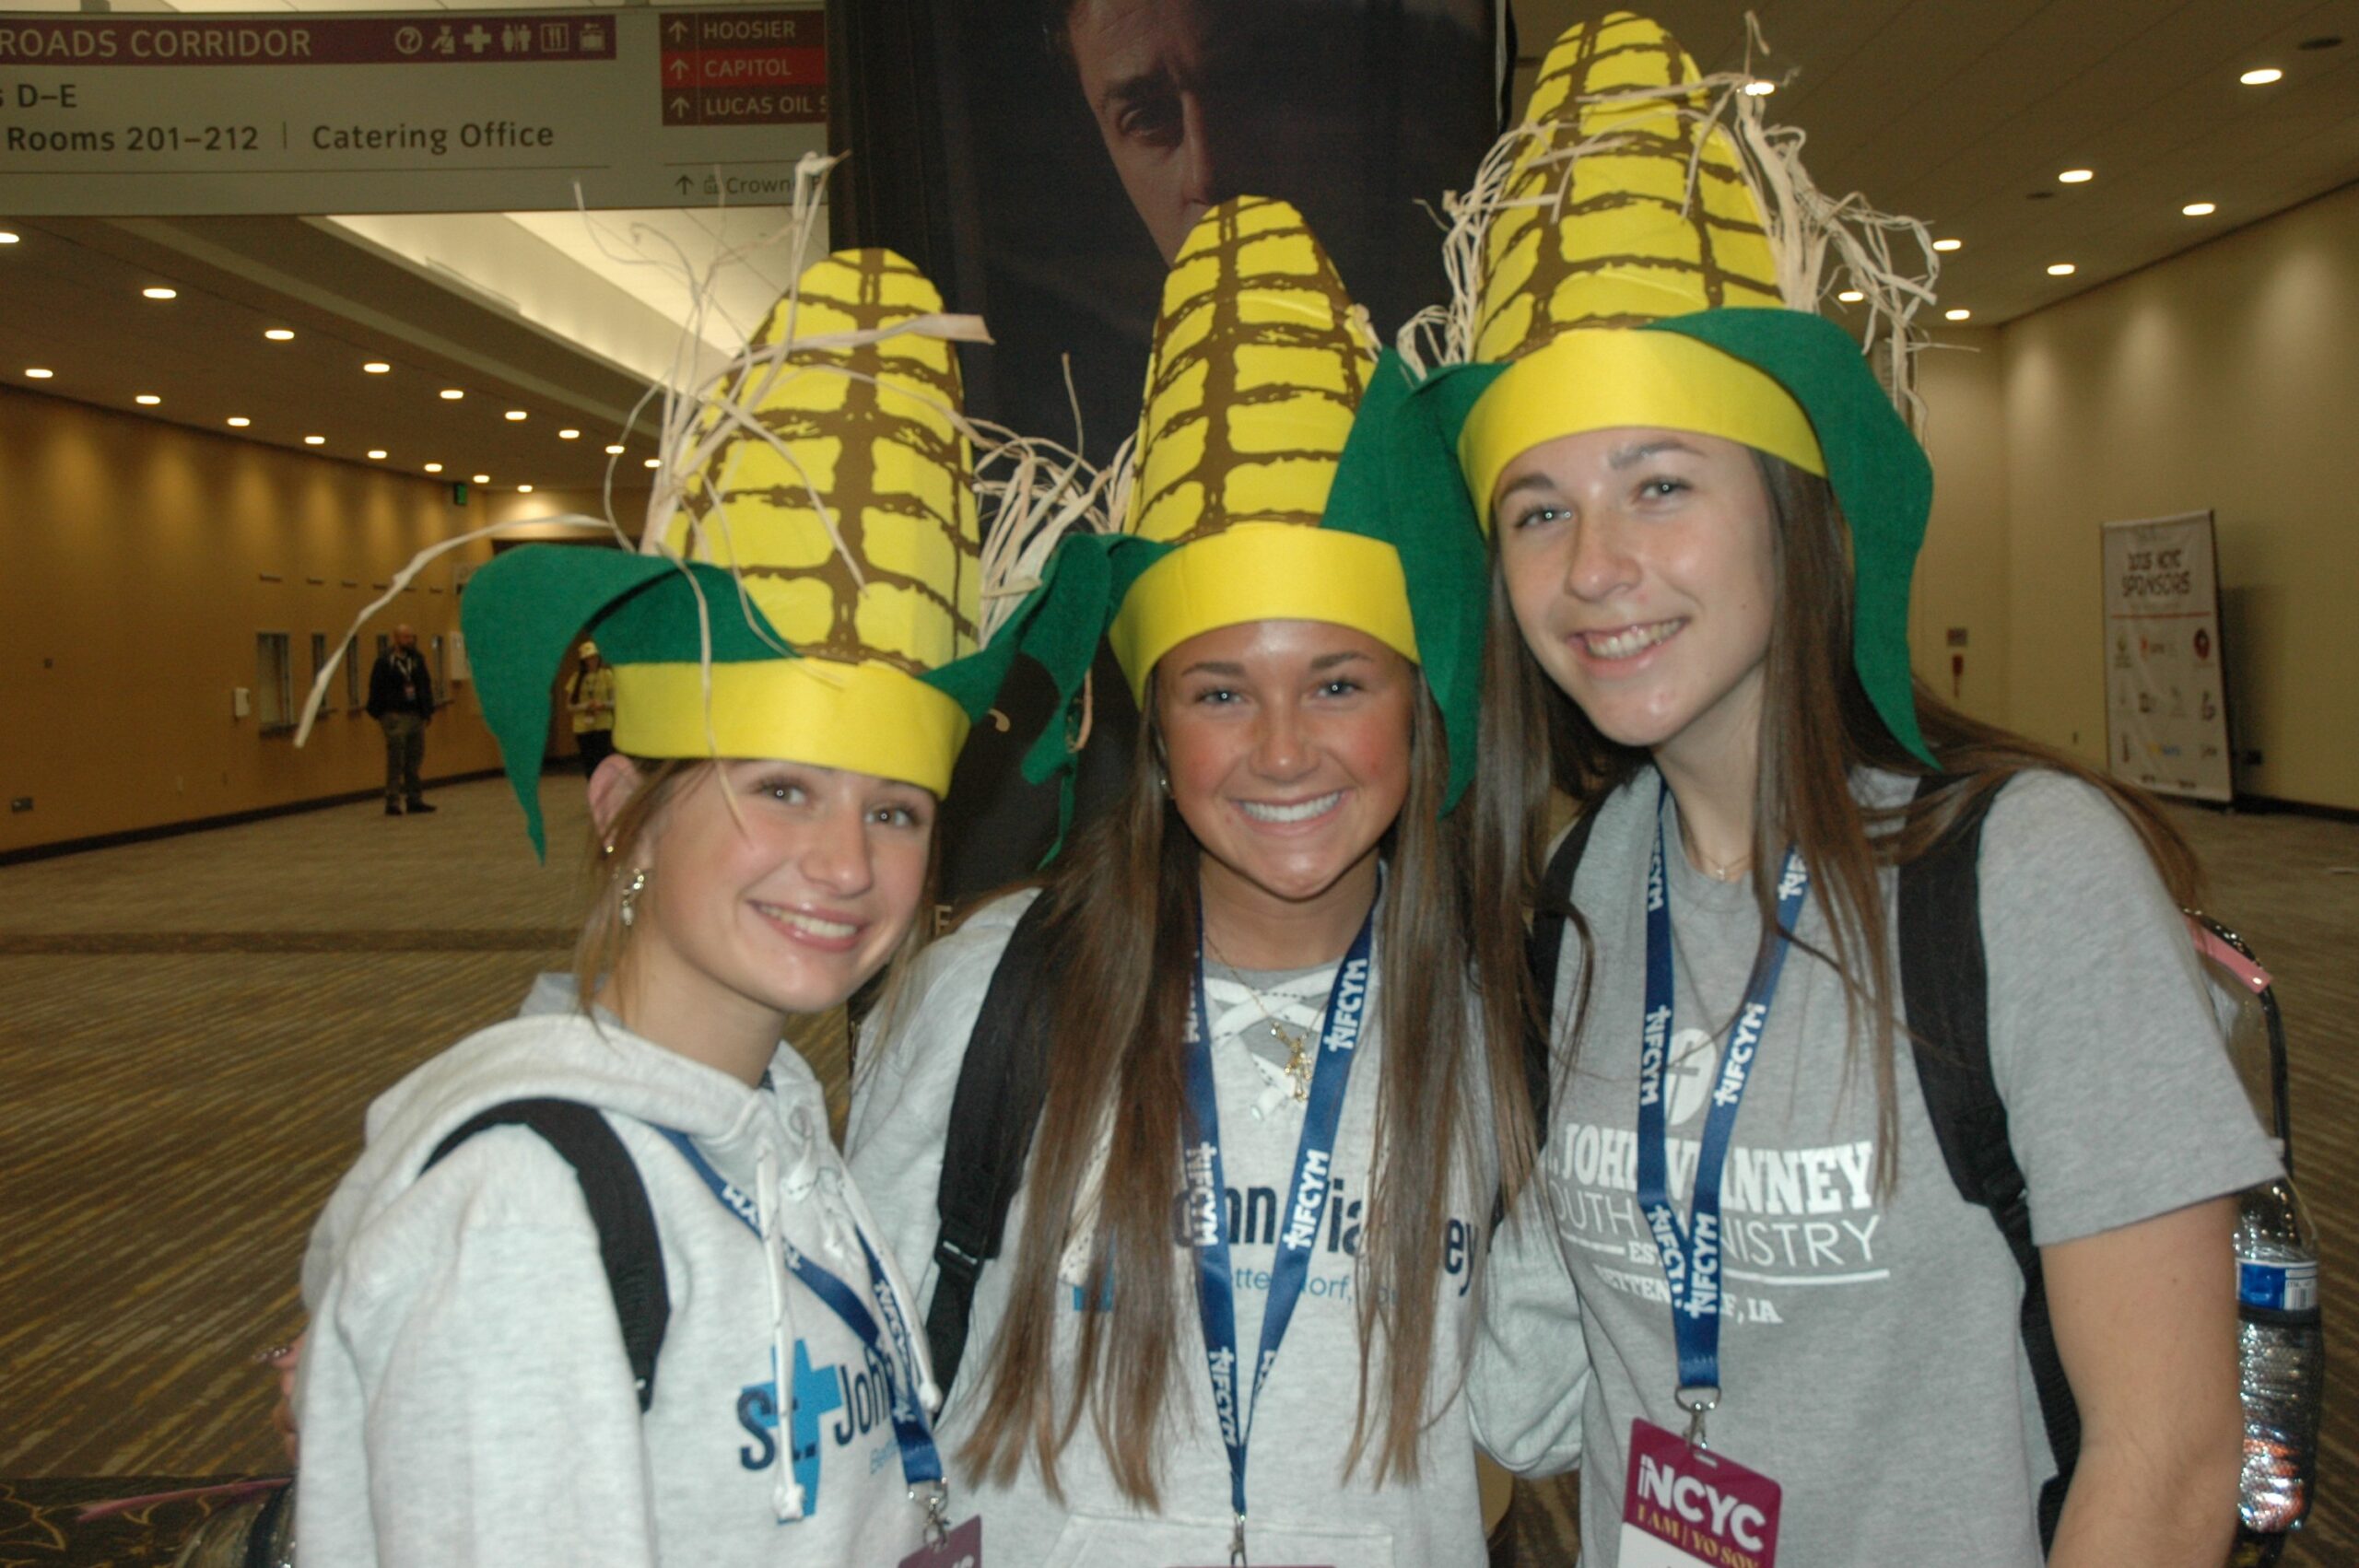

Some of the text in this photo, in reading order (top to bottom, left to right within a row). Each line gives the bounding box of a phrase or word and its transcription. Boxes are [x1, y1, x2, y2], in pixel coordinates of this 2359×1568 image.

[131, 29, 311, 57] CORRIDOR
[704, 20, 795, 40] HOOSIER
[704, 58, 792, 77] CAPITOL
[7, 127, 115, 151] Rooms
[312, 123, 447, 155] Catering
[461, 122, 553, 147] Office
[705, 97, 773, 116] LUCAS
[780, 95, 813, 113] OIL
[726, 176, 795, 194] Crown
[1324, 958, 1367, 1052] NFCYM
[1640, 1004, 1672, 1106] NFCYM
[1713, 1003, 1766, 1107] NFCYM
[1186, 1141, 1219, 1246] NFCYM
[1282, 1148, 1330, 1250] NFCYM
[1684, 1211, 1719, 1319] NFCYM
[1637, 1454, 1766, 1552] NCYC
[1637, 1504, 1646, 1523] I
[1648, 1511, 1681, 1539] AM
[1691, 1529, 1719, 1559] YO
